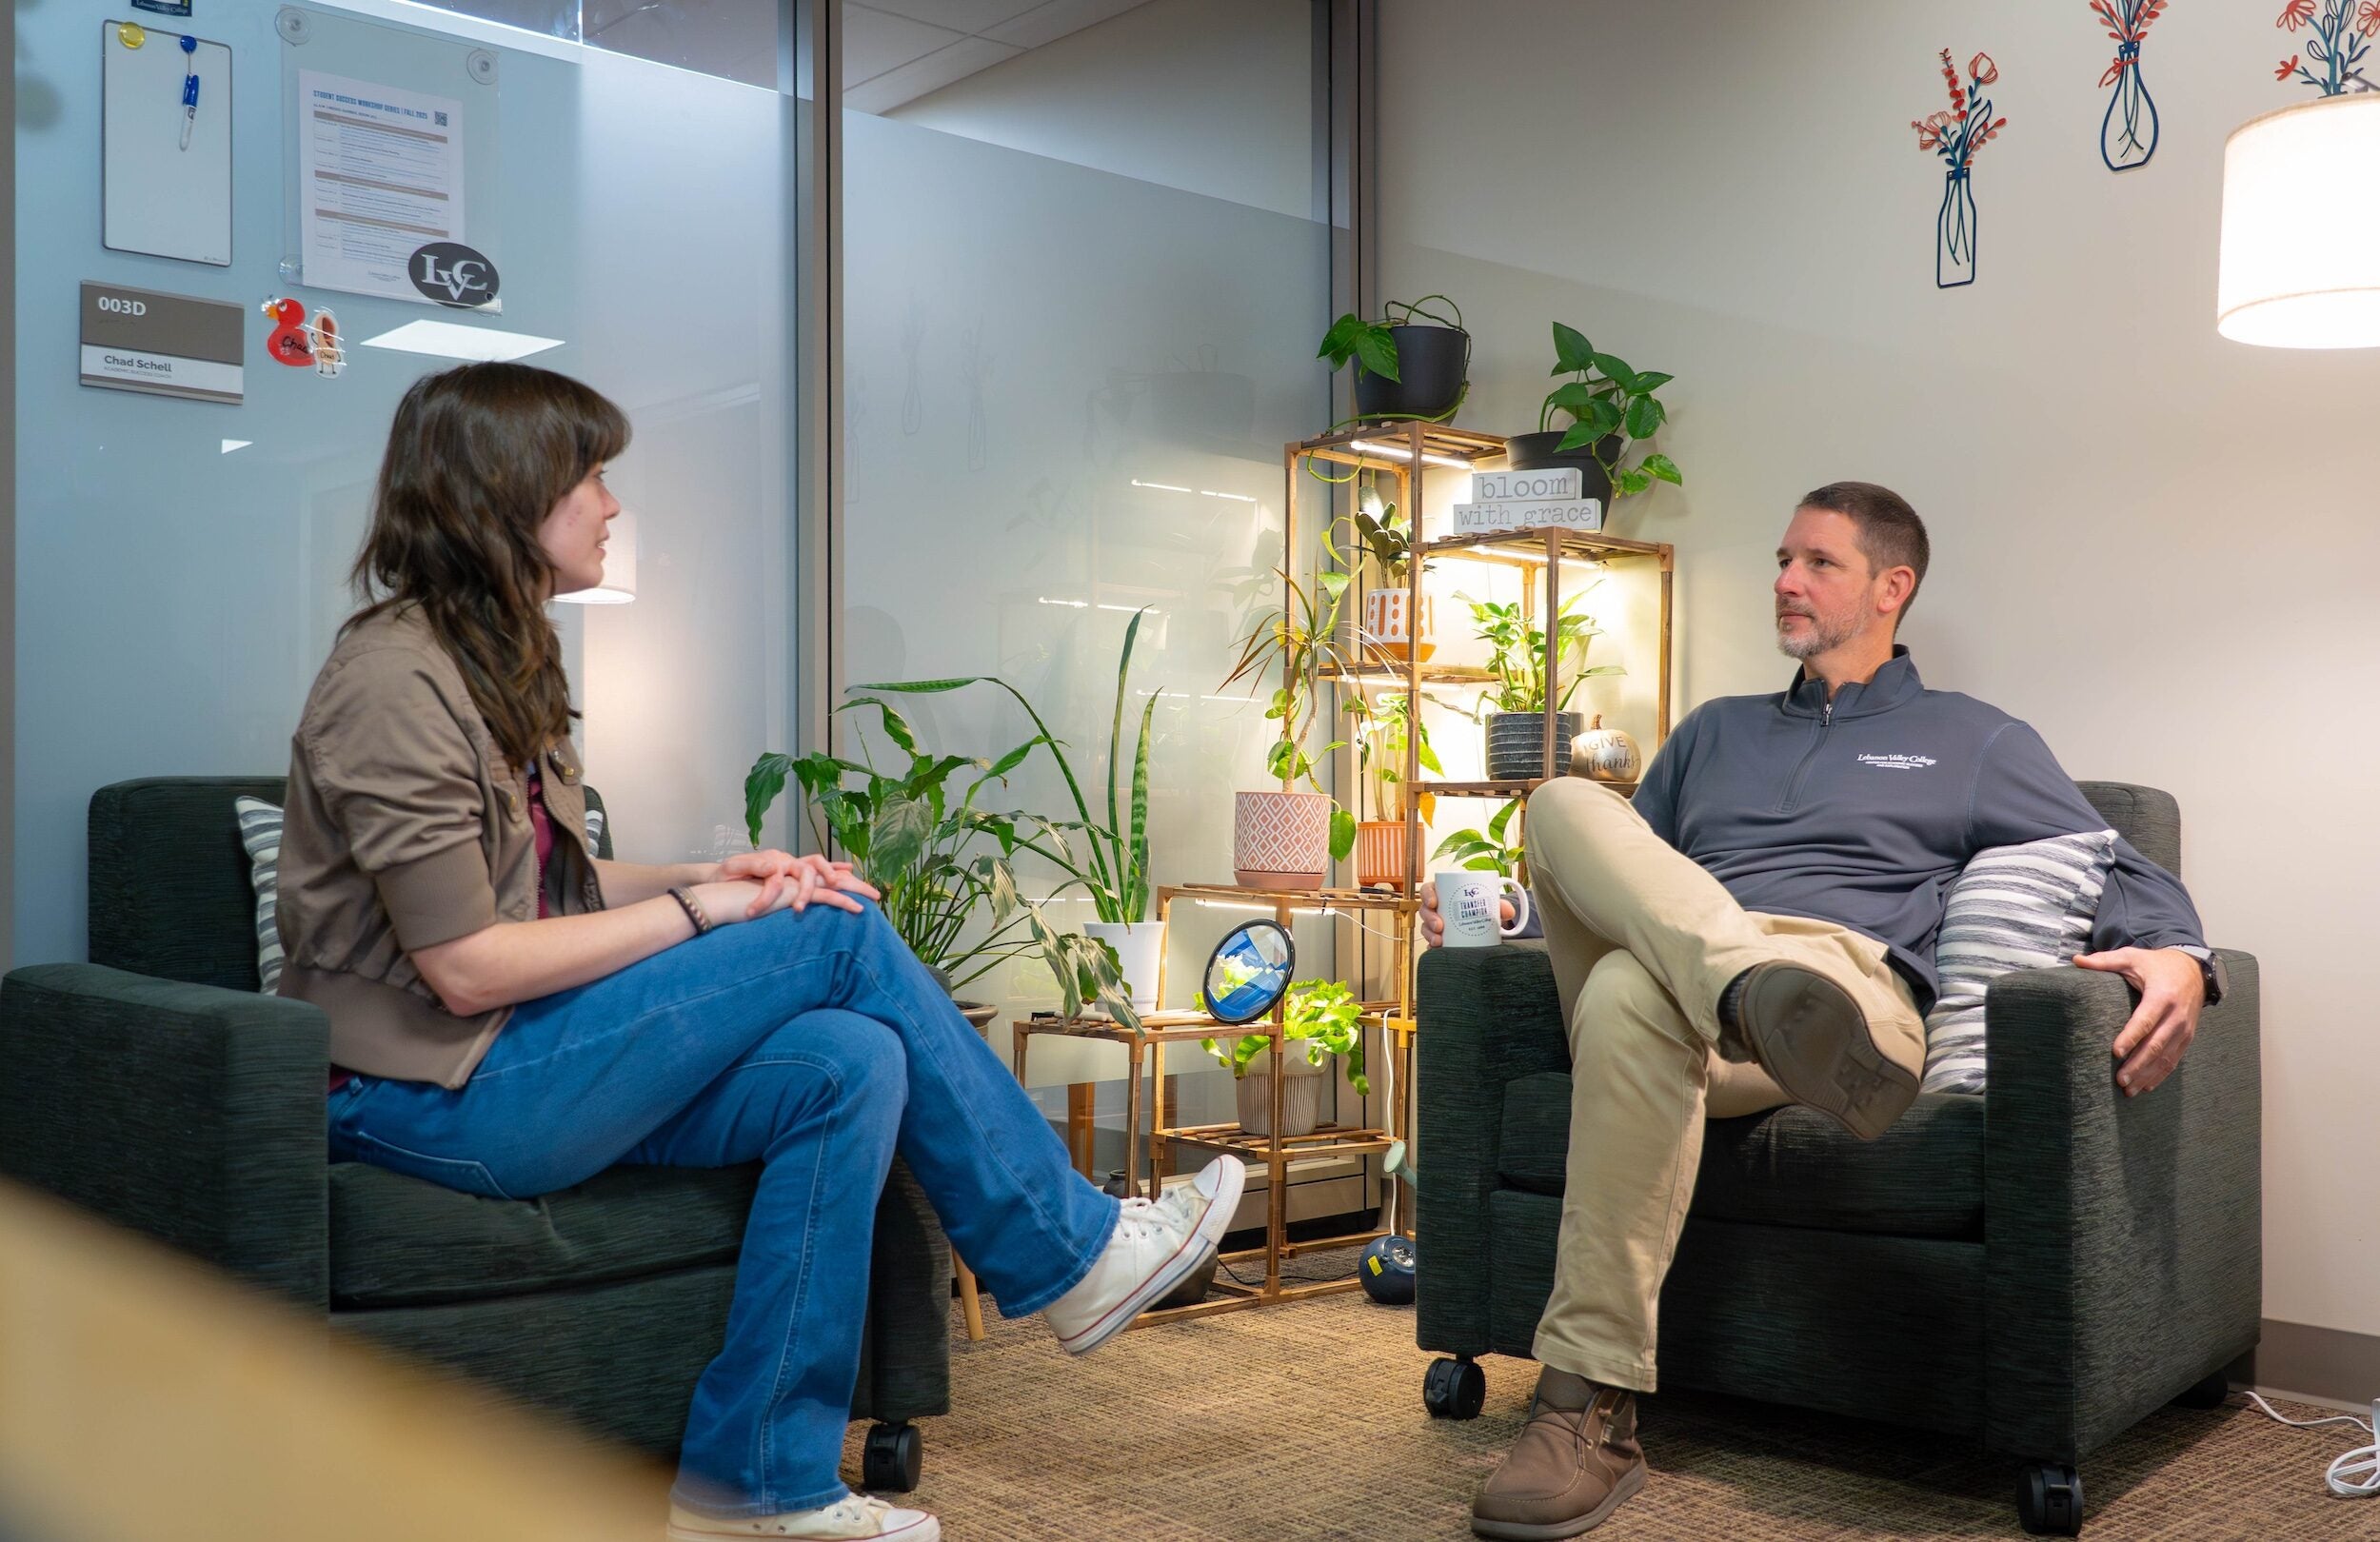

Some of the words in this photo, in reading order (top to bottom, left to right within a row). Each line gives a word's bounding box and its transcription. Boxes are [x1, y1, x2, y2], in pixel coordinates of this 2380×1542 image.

[313, 89, 334, 100] STUDENT
[336, 95, 357, 105] SUCCESS
[358, 99, 384, 110] WORKSHOP
[385, 105, 400, 114] SERIES
[404, 109, 414, 117] FALL
[416, 110, 427, 120] 2025
[98, 296, 147, 317] 003D
[104, 355, 134, 367] Chad
[136, 359, 172, 372] Schell
[1478, 476, 1568, 499] bloom
[1458, 504, 1512, 525] with
[1523, 505, 1592, 528] grace
[1589, 736, 1626, 750] GIVE
[1460, 899, 1486, 910] TRANSFER
